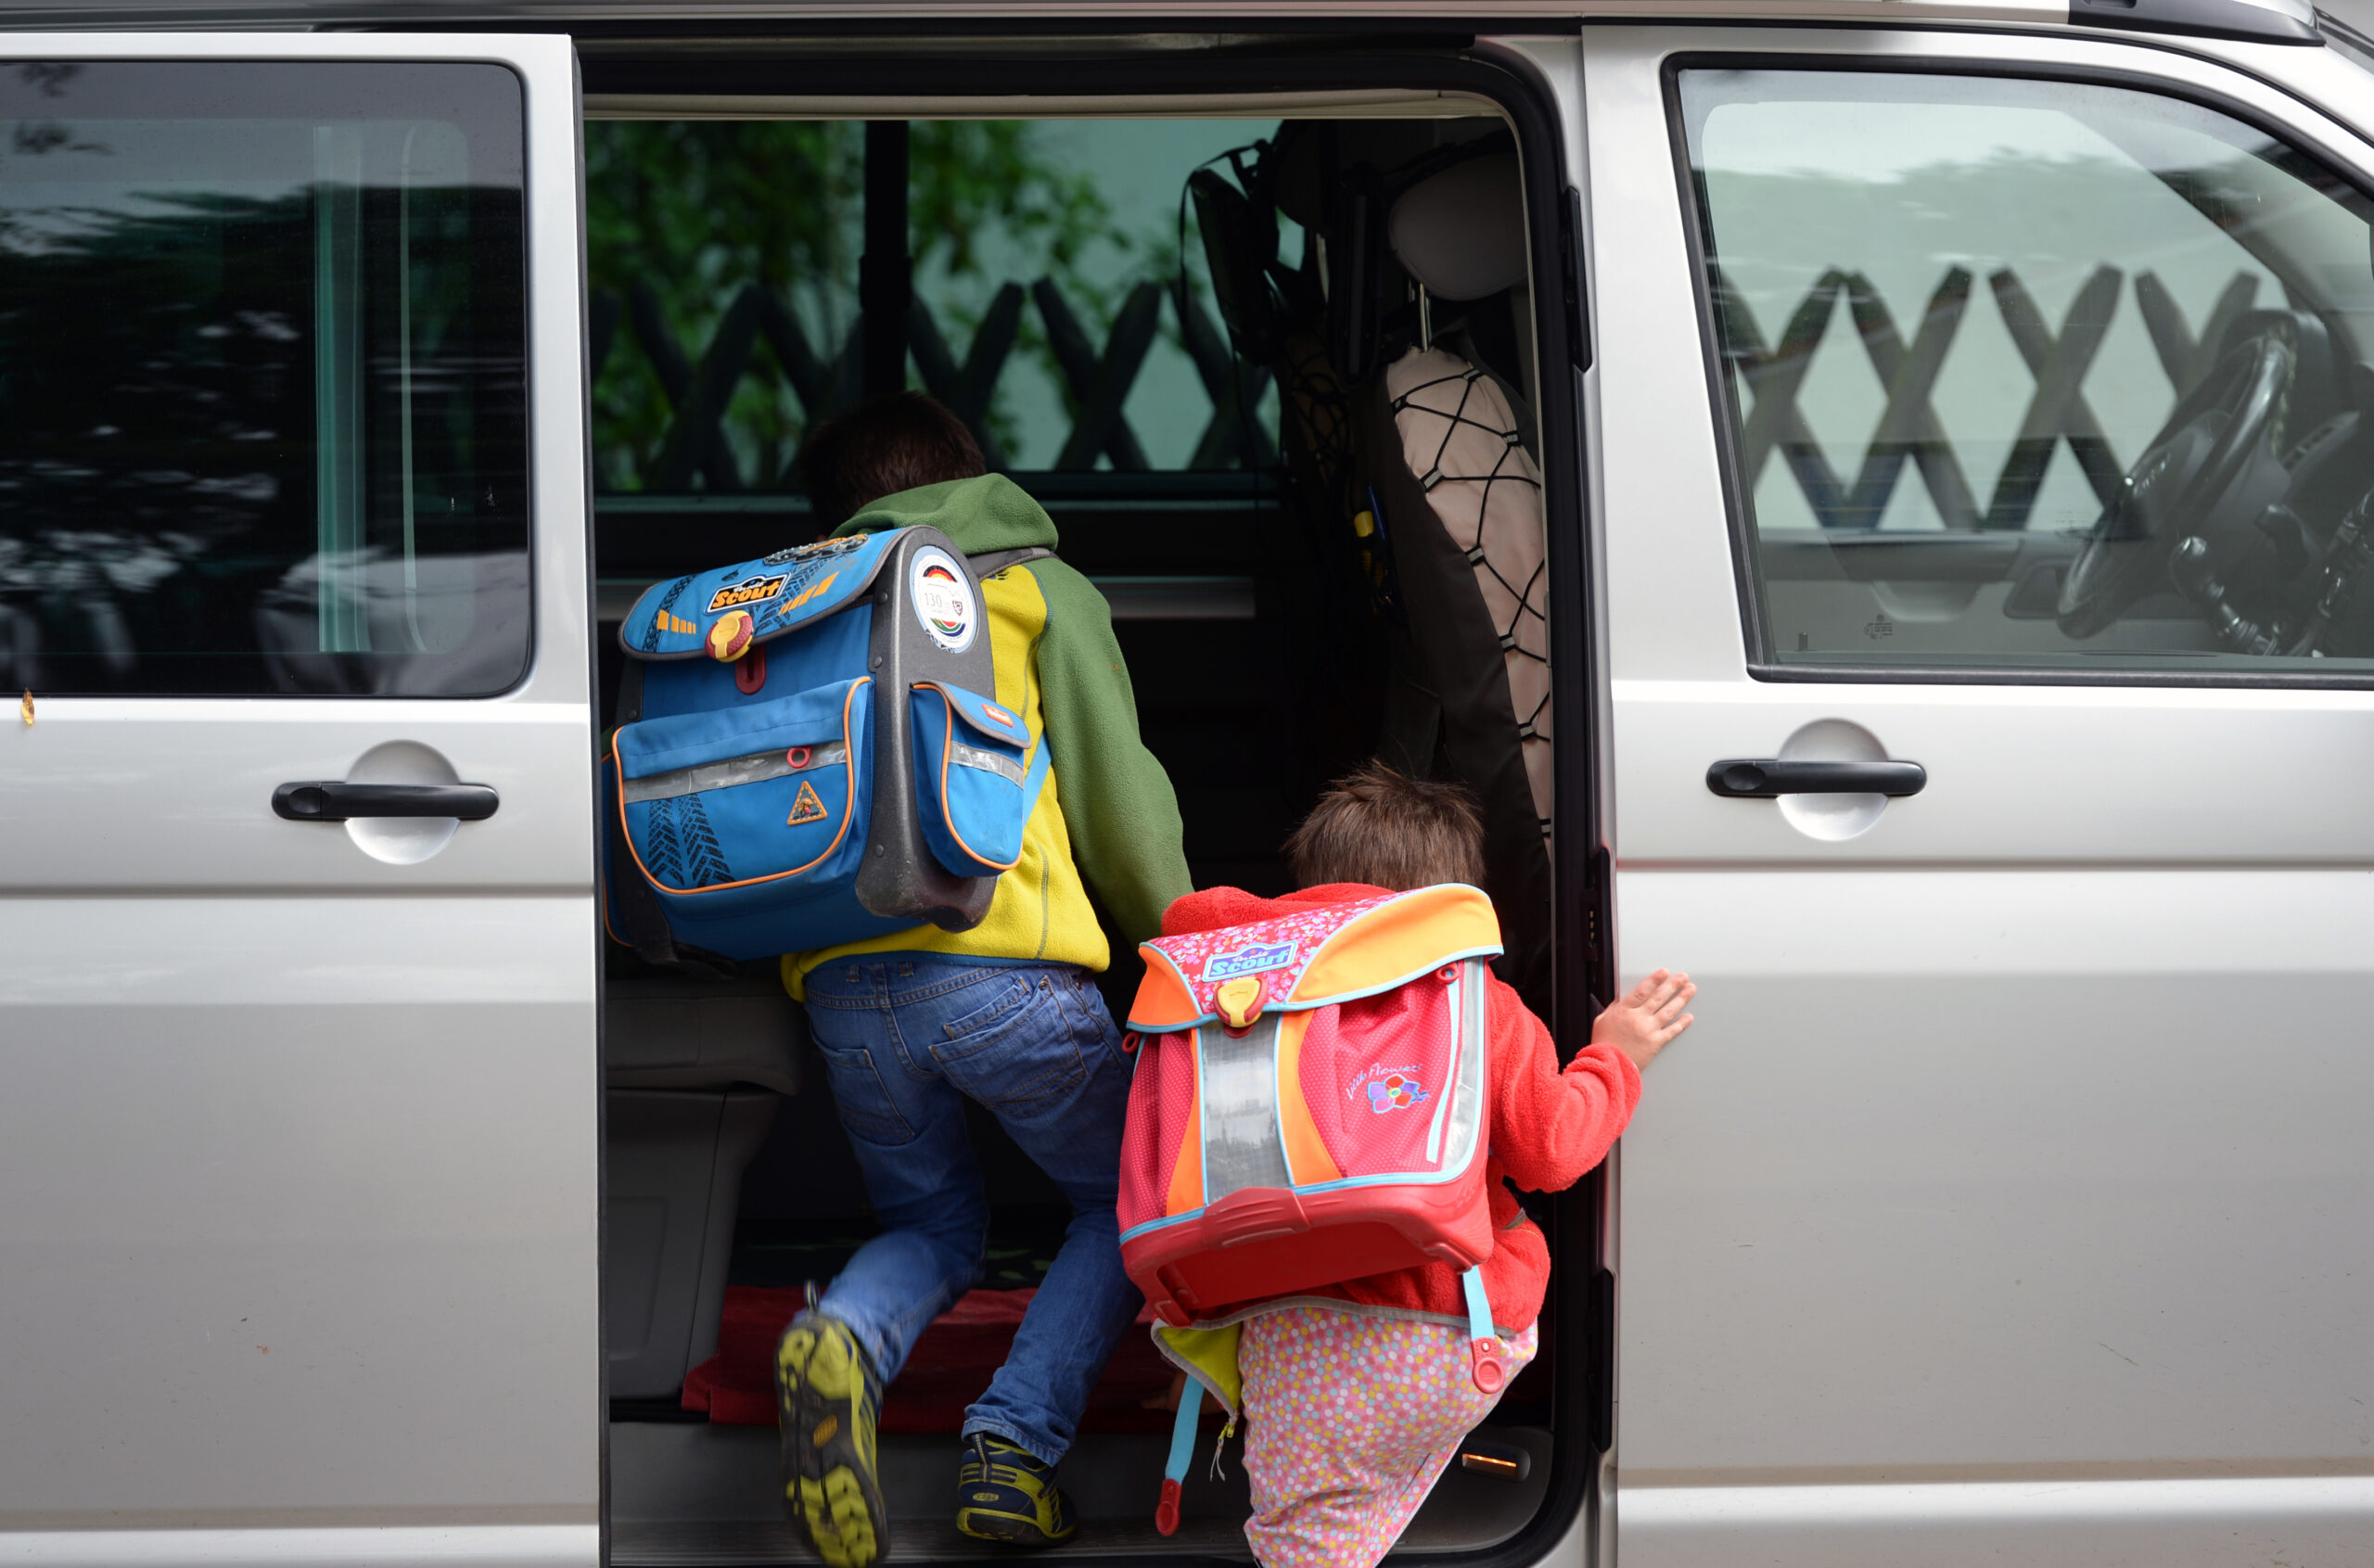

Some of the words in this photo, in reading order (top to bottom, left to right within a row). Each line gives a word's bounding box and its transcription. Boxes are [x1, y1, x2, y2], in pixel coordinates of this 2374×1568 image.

[712, 580, 782, 608] Scout
[925, 593, 942, 608] 130
[1210, 950, 1289, 976] Scout
